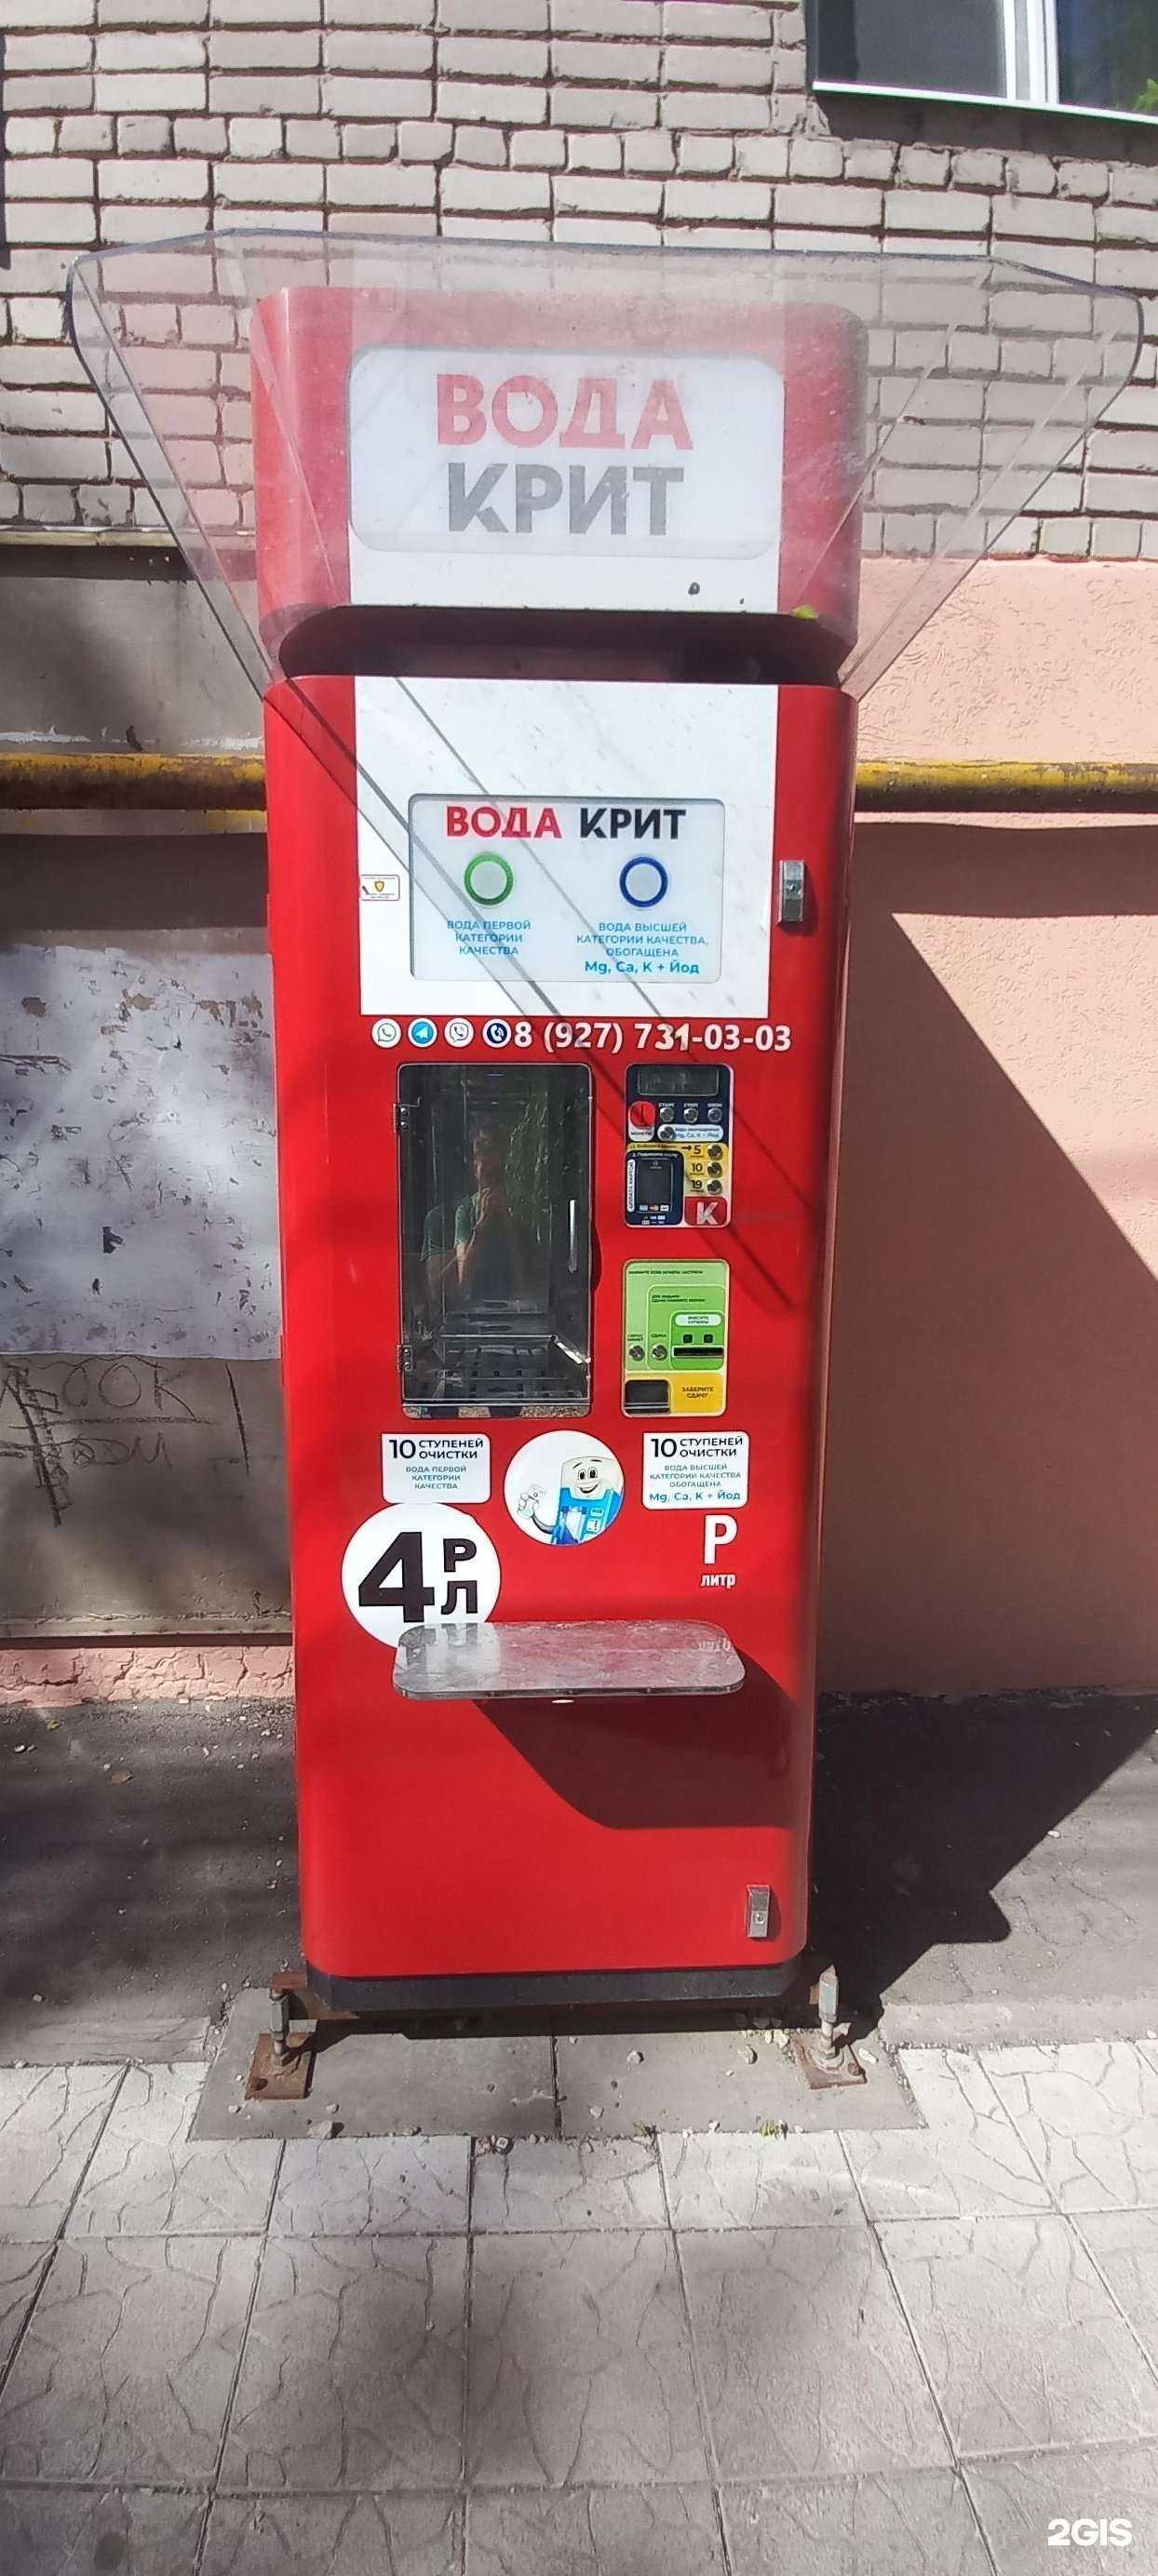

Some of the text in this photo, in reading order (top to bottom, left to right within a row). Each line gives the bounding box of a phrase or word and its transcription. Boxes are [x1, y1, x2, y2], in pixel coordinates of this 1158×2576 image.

[437, 373, 693, 450] ВОДА
[448, 462, 684, 537] КРИТ
[446, 805, 686, 840] ВОДА КРИТ
[447, 919, 531, 931] ВОДА ПЕРВОЙ
[599, 921, 687, 932] ВОДА ВЫСШЕЙ
[455, 933, 523, 943] КАТЕГОРИИ
[576, 934, 709, 946] КАТЕГОРИИ КАЧЕСТВА,
[459, 946, 519, 955] КАЧЕСТВА
[606, 947, 679, 958] ОБОГАЩЕНА
[585, 960, 612, 974] Mg,
[615, 960, 639, 974] Ca,
[669, 959, 700, 974] Йод
[513, 1022, 792, 1054] 8 (927) 731-03-03
[693, 1145, 702, 1155] 5
[692, 1163, 703, 1173] 10
[691, 1180, 703, 1189] 19
[696, 1201, 719, 1225] К
[389, 1437, 483, 1459] 10 СТУПЕНЕЙ
[651, 1436, 743, 1458] 10 СТУПЕНЕЙ
[680, 1448, 737, 1457] ОЧИСТКИ
[418, 1450, 478, 1459] ОЧИСТКИ
[690, 1463, 727, 1471] ВЫСШЕЙ
[699, 1471, 742, 1480] КАЧЕСТВА
[649, 1493, 670, 1503] Mg,
[674, 1492, 692, 1502] Ca,
[717, 1490, 741, 1500] Йод
[704, 1514, 738, 1564] Р
[443, 1538, 478, 1573] Р
[357, 1532, 436, 1624] 4
[700, 1574, 736, 1590] литр
[440, 1580, 478, 1616] Л
